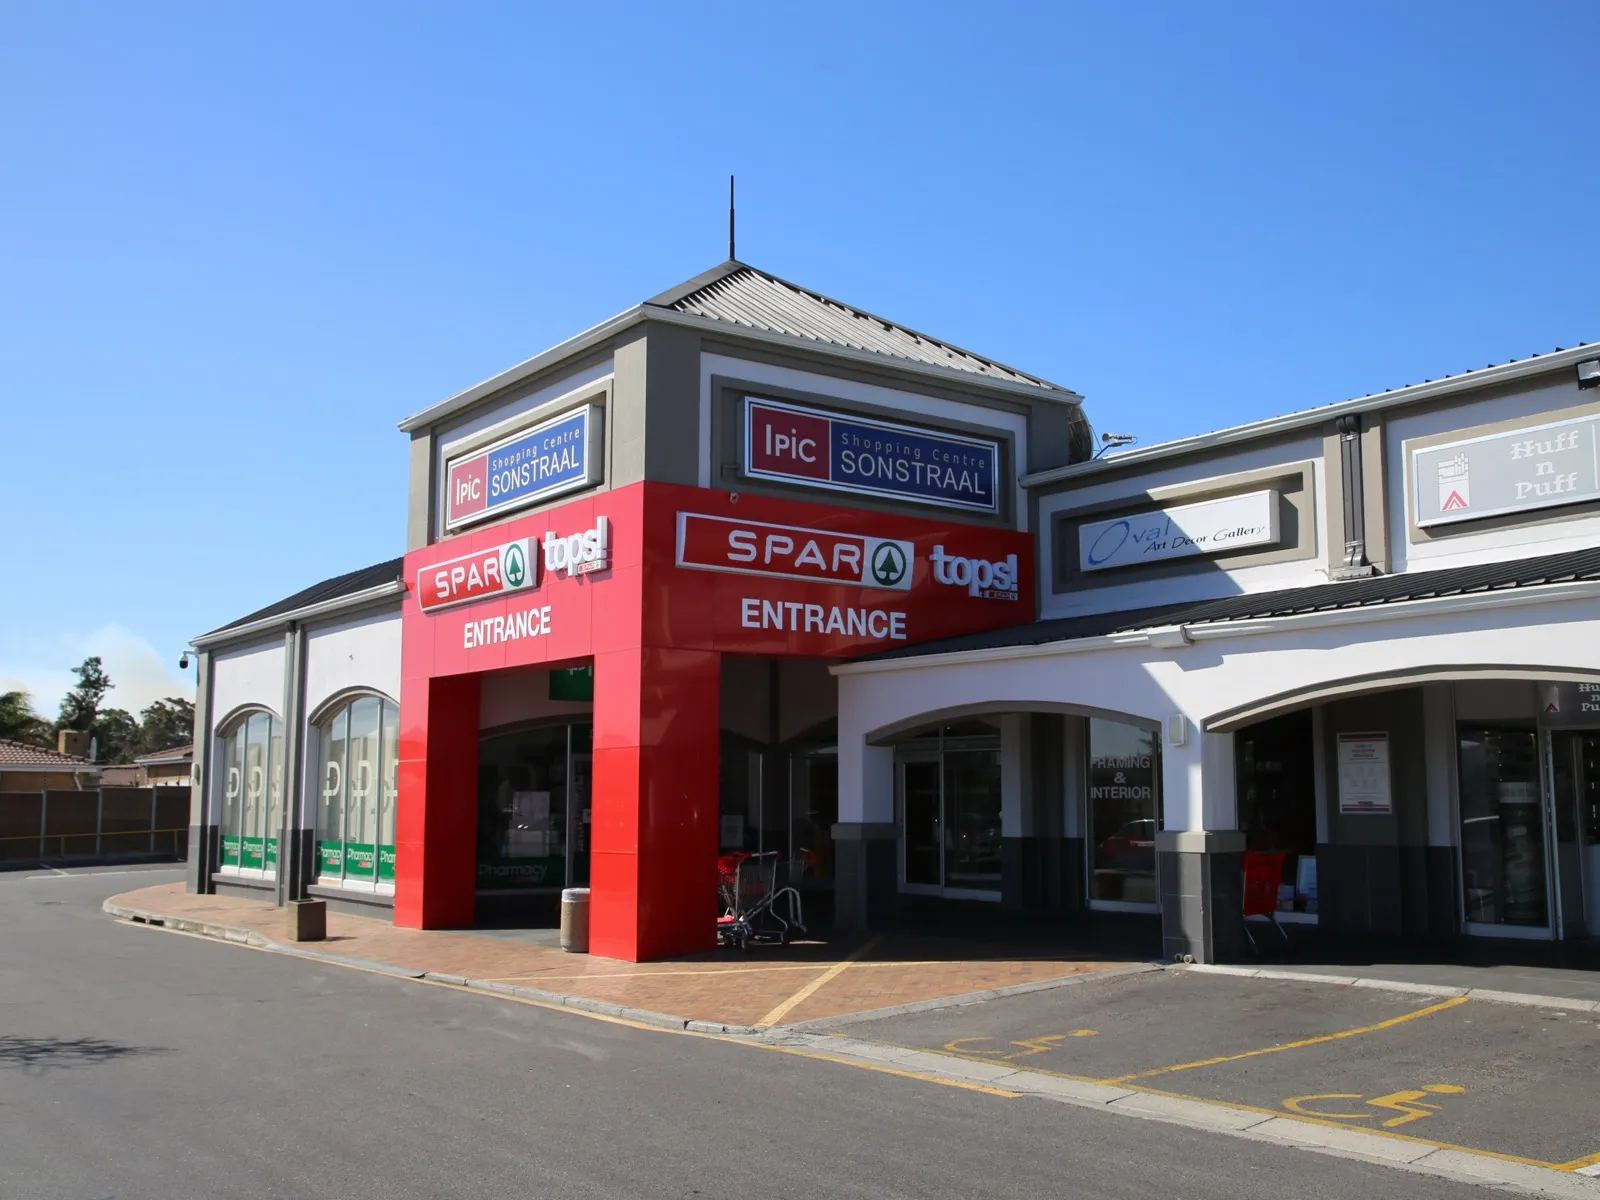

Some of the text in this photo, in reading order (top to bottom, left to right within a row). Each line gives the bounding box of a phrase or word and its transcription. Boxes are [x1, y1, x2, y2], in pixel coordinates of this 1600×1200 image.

[492, 428, 580, 471] Shopping Centre
[842, 432, 985, 469] Shopping Centre
[1510, 430, 1579, 460] Huff
[491, 445, 580, 497] SONSTRAAL
[841, 450, 986, 495] SONSTRAAL
[1515, 472, 1577, 500] Puff
[1535, 461, 1555, 476] n
[542, 516, 608, 576] tops!
[727, 529, 861, 575] SPAR
[1088, 516, 1171, 566] Oval
[1143, 526, 1265, 554] Art Decor Gallery
[435, 556, 501, 598] SPAR
[929, 544, 1018, 597] tops!
[464, 605, 551, 649] ENTRANCE
[741, 598, 907, 640] ENTRANCE
[1090, 756, 1151, 769] FRAMING
[1114, 772, 1126, 784] &
[1090, 786, 1151, 799] INTERIOR
